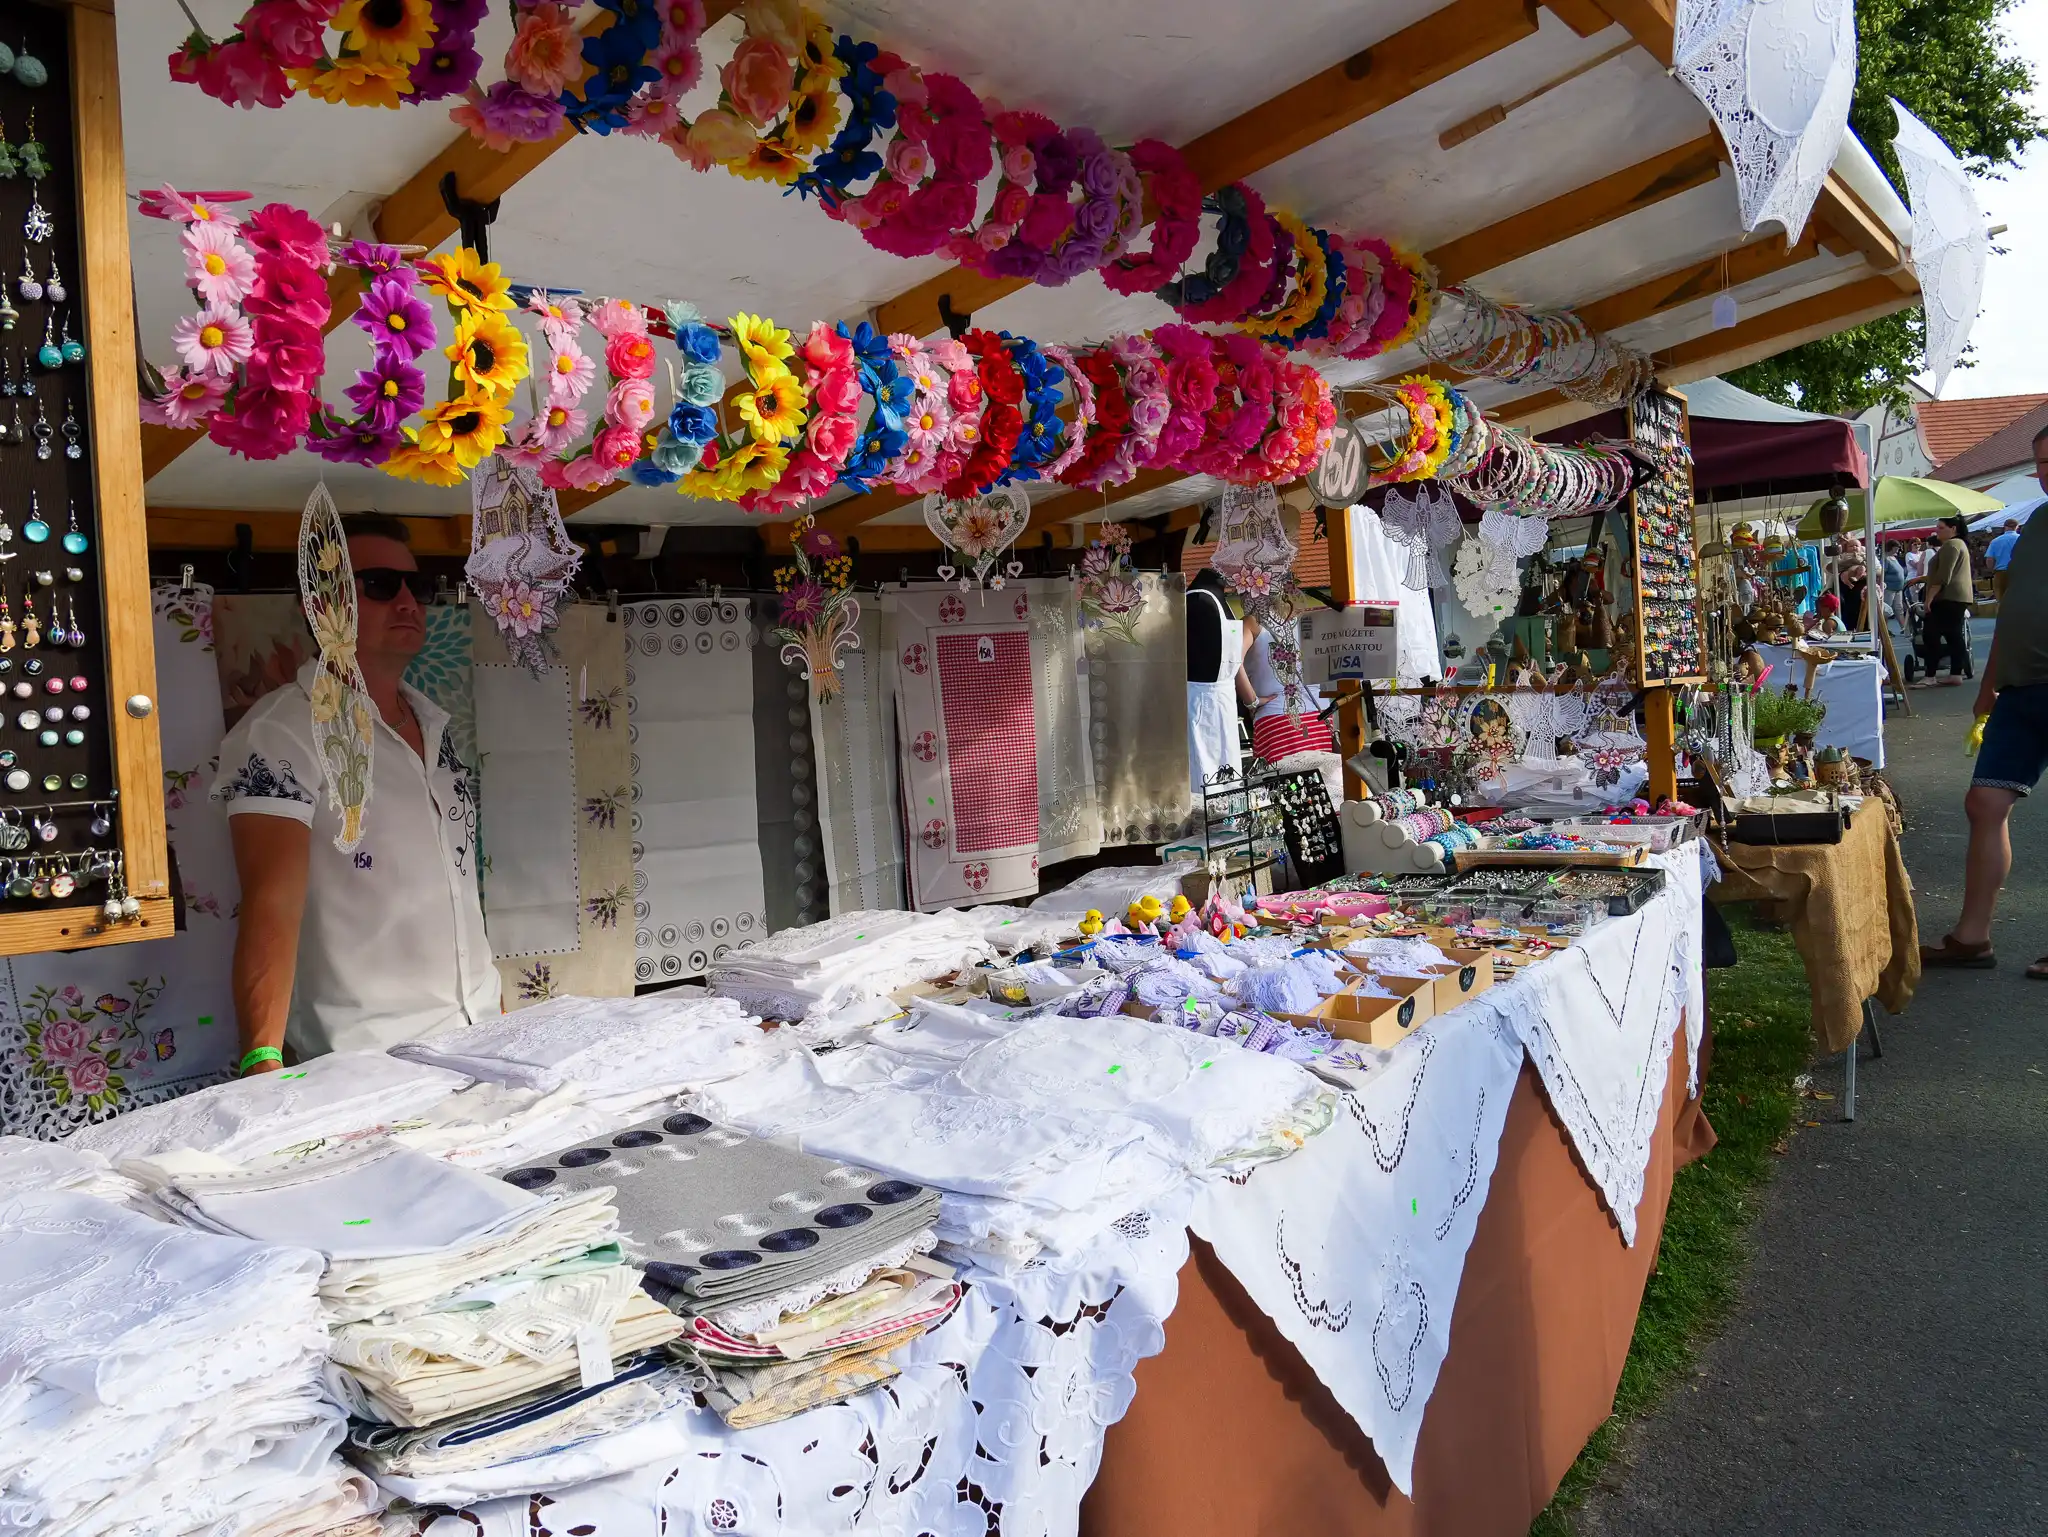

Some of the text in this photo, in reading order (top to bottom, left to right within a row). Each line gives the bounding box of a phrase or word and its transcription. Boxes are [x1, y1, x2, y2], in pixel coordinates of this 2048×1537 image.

[1320, 631, 1339, 641] ZDE
[1341, 642, 1383, 652] KARTOU
[1332, 655, 1361, 669] VISA
